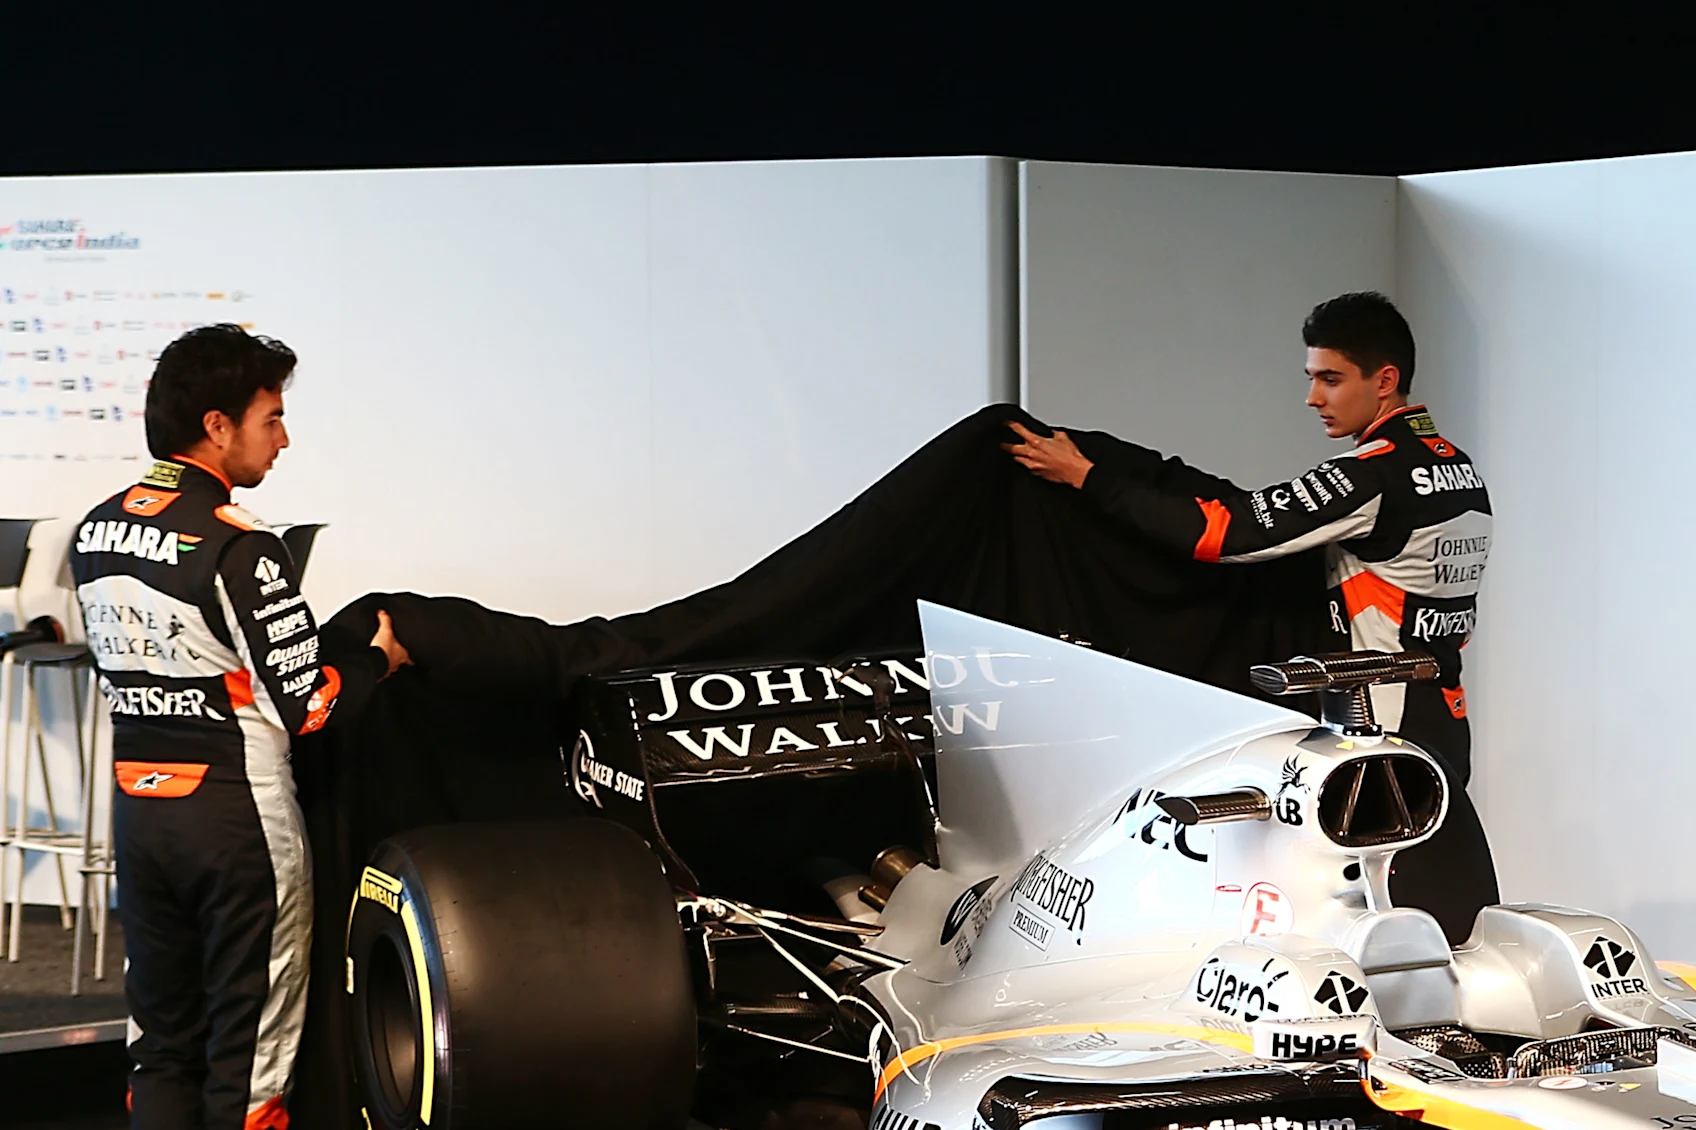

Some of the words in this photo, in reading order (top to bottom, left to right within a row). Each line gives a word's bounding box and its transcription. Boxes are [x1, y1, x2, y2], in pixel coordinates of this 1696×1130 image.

[76, 520, 179, 566] SAHARA
[265, 609, 308, 639] HYPE
[276, 648, 319, 677] STATE
[614, 770, 645, 801] STATE
[359, 866, 404, 915] PIRELLI
[1012, 910, 1049, 945] PREMIUM
[1196, 957, 1265, 1023] Claro
[1591, 978, 1648, 998] INTER
[1271, 1032, 1358, 1059] HYPE
